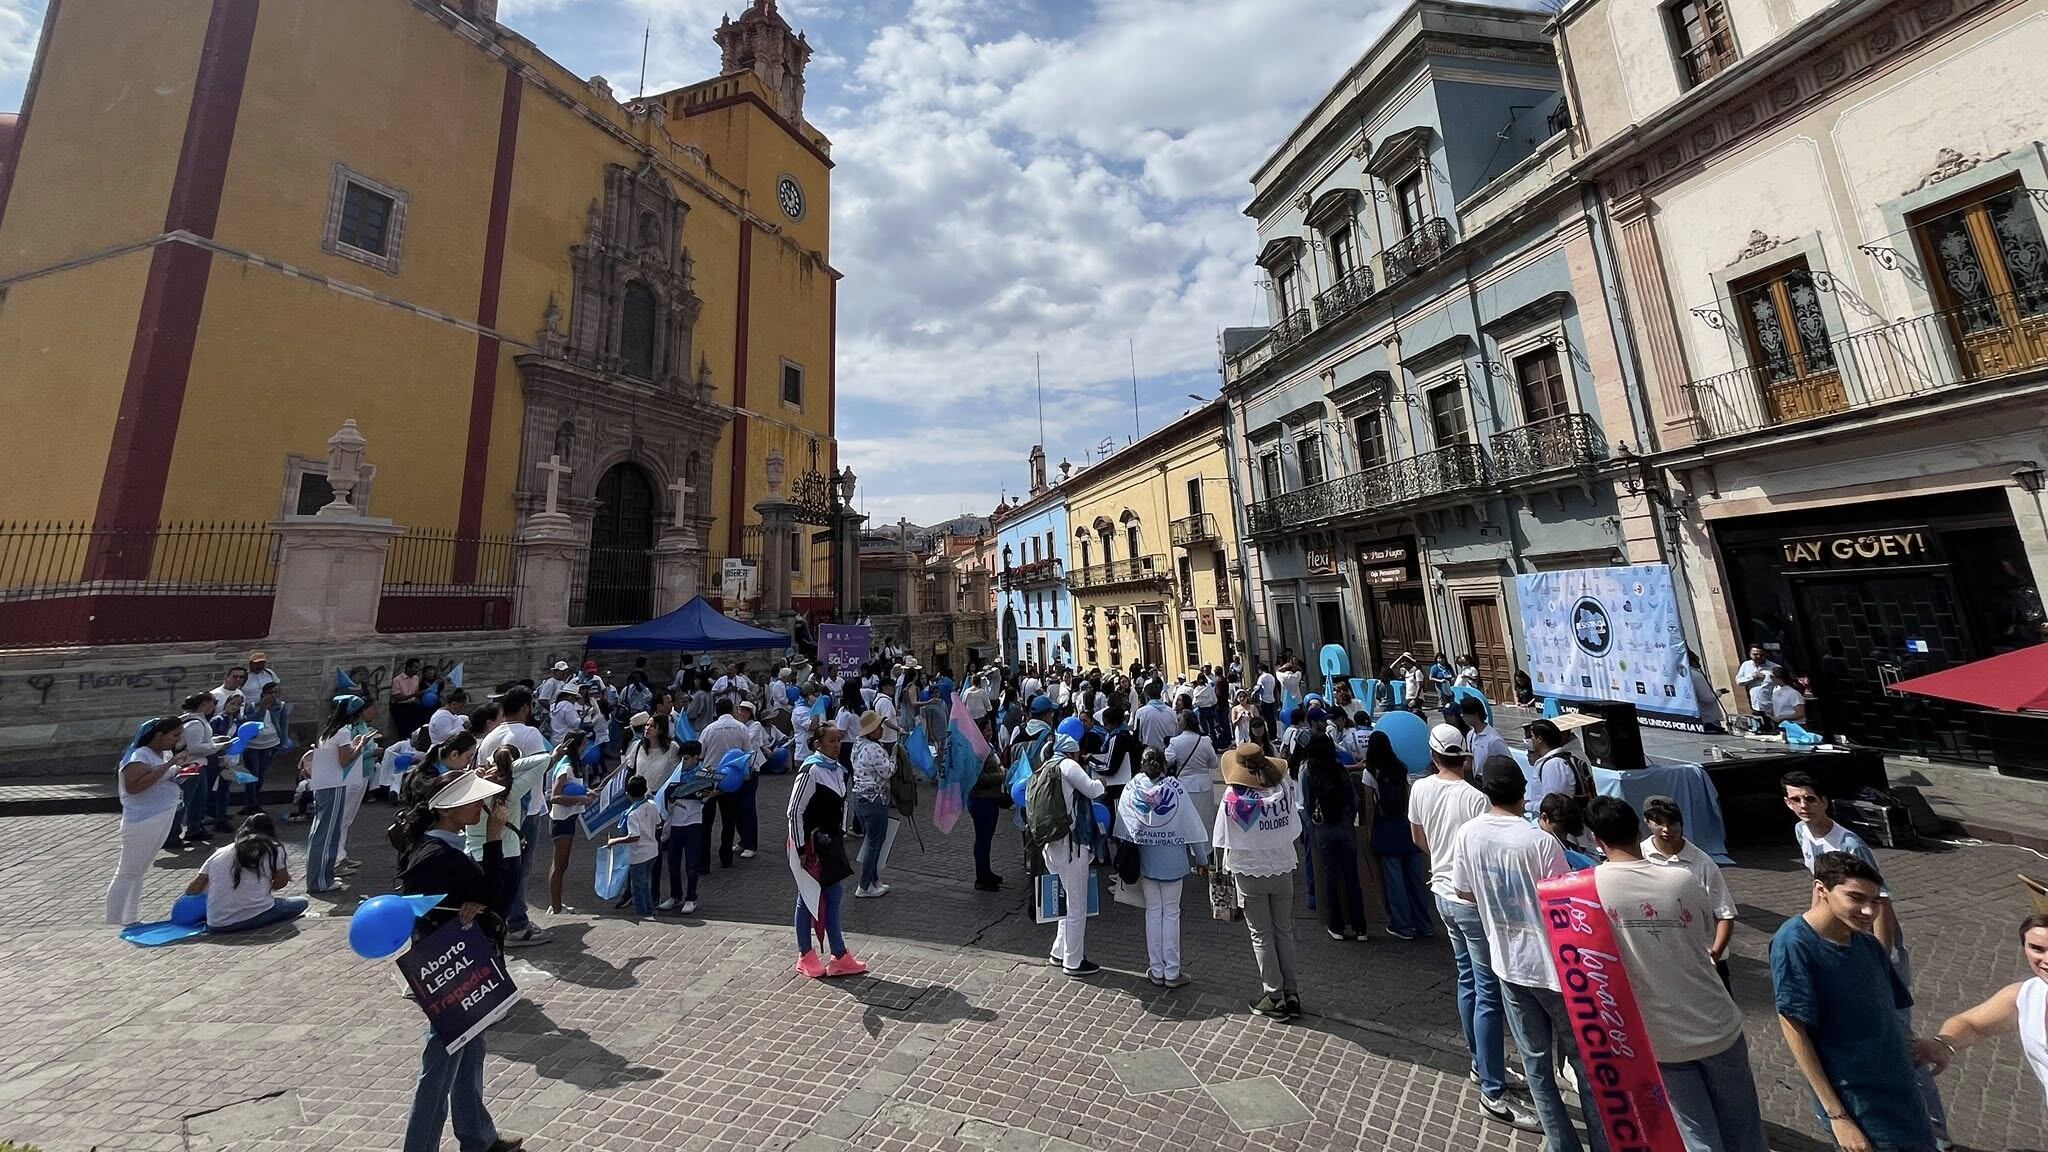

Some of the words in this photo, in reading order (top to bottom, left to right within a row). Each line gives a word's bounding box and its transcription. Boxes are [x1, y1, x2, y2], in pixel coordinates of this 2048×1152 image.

[1306, 549, 1329, 568] flexi
[1260, 816, 1289, 831] DOLORES
[420, 941, 466, 980] Aborto
[426, 956, 474, 994] LEGAL
[428, 965, 492, 1015] Tragedia
[460, 979, 500, 1011] REAL
